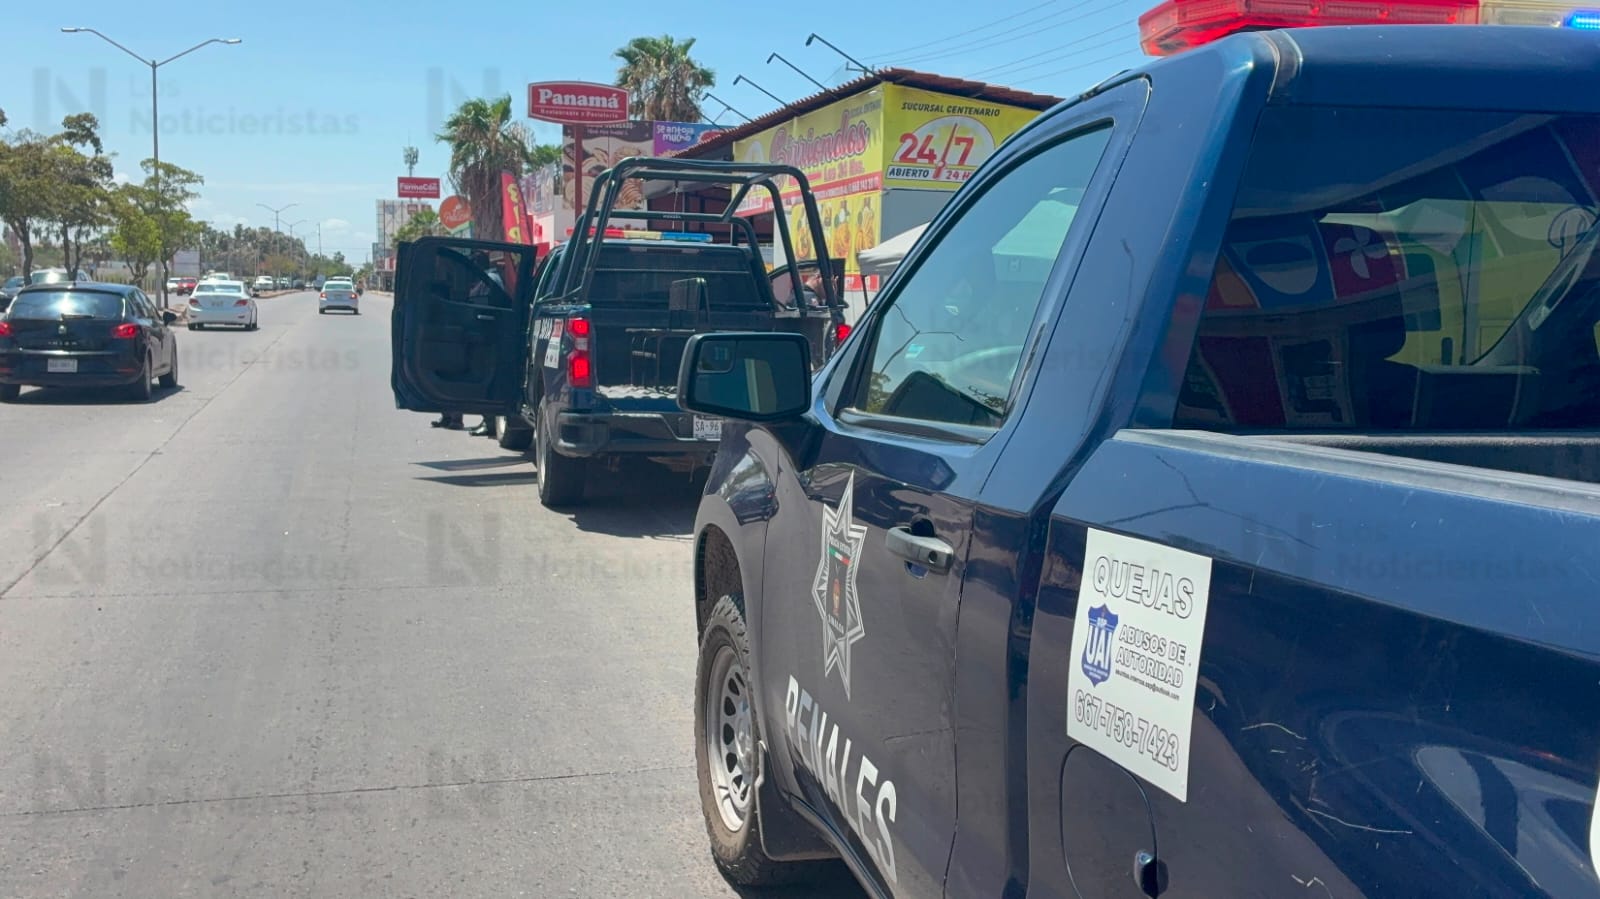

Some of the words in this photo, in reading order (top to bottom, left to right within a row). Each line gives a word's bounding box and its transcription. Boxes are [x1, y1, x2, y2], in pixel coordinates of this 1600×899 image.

[538, 88, 619, 109] Panamá
[901, 102, 944, 113] SUCURSAL
[946, 104, 1000, 117] CENTENARIO
[888, 168, 929, 179] ABIERTO
[1093, 556, 1194, 619] QUEJAS
[1085, 625, 1113, 671] UAI
[1118, 624, 1167, 657] ABUSOS
[1168, 641, 1187, 665] DE
[1115, 646, 1184, 689] AUTORIDAD
[1074, 688, 1180, 772] 667-758-7423
[785, 674, 897, 886] PENALES
